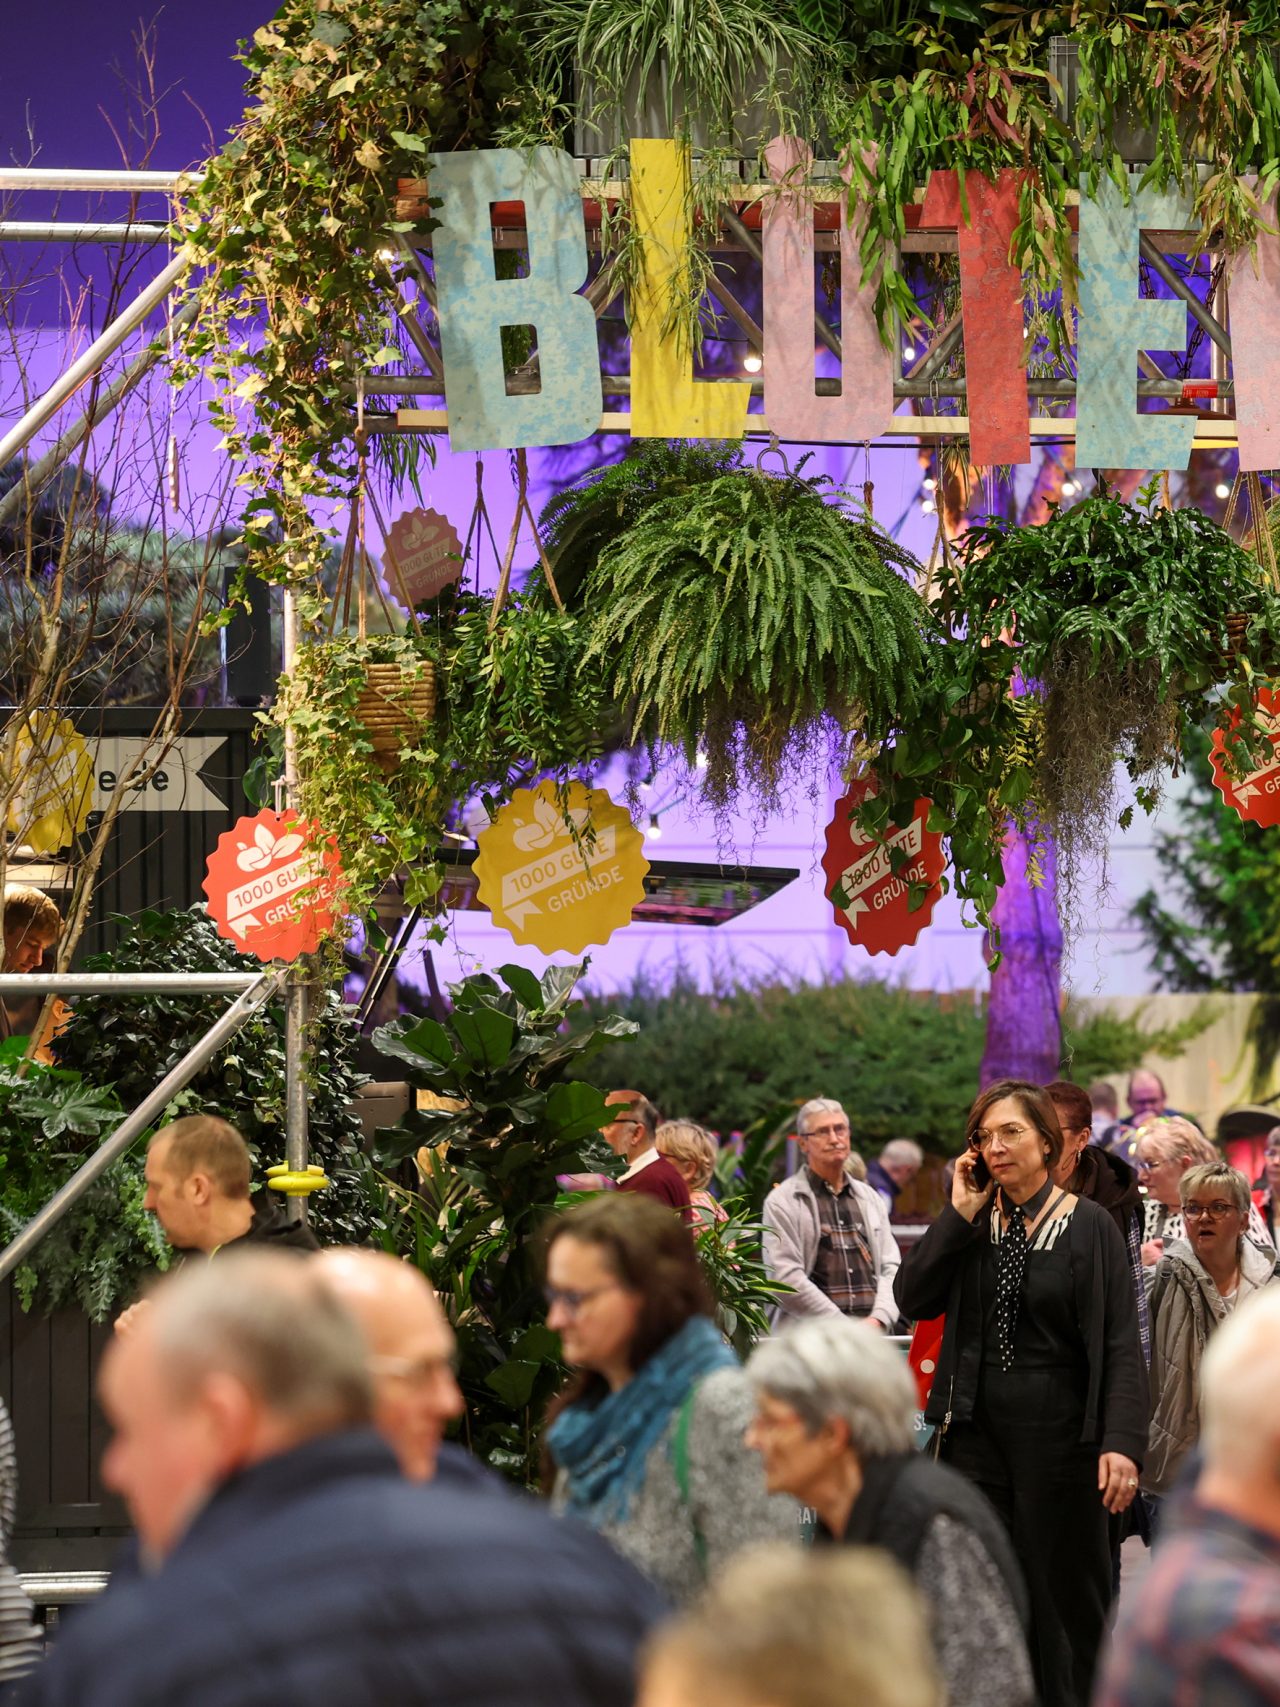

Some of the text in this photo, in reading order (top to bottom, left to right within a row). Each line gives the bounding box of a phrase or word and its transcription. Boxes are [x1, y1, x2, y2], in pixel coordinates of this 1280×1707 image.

[510, 835, 609, 894] 1000 GUE
[882, 830, 918, 866] GTE
[234, 880, 274, 908] 1000
[547, 865, 625, 913] GRÜNDE
